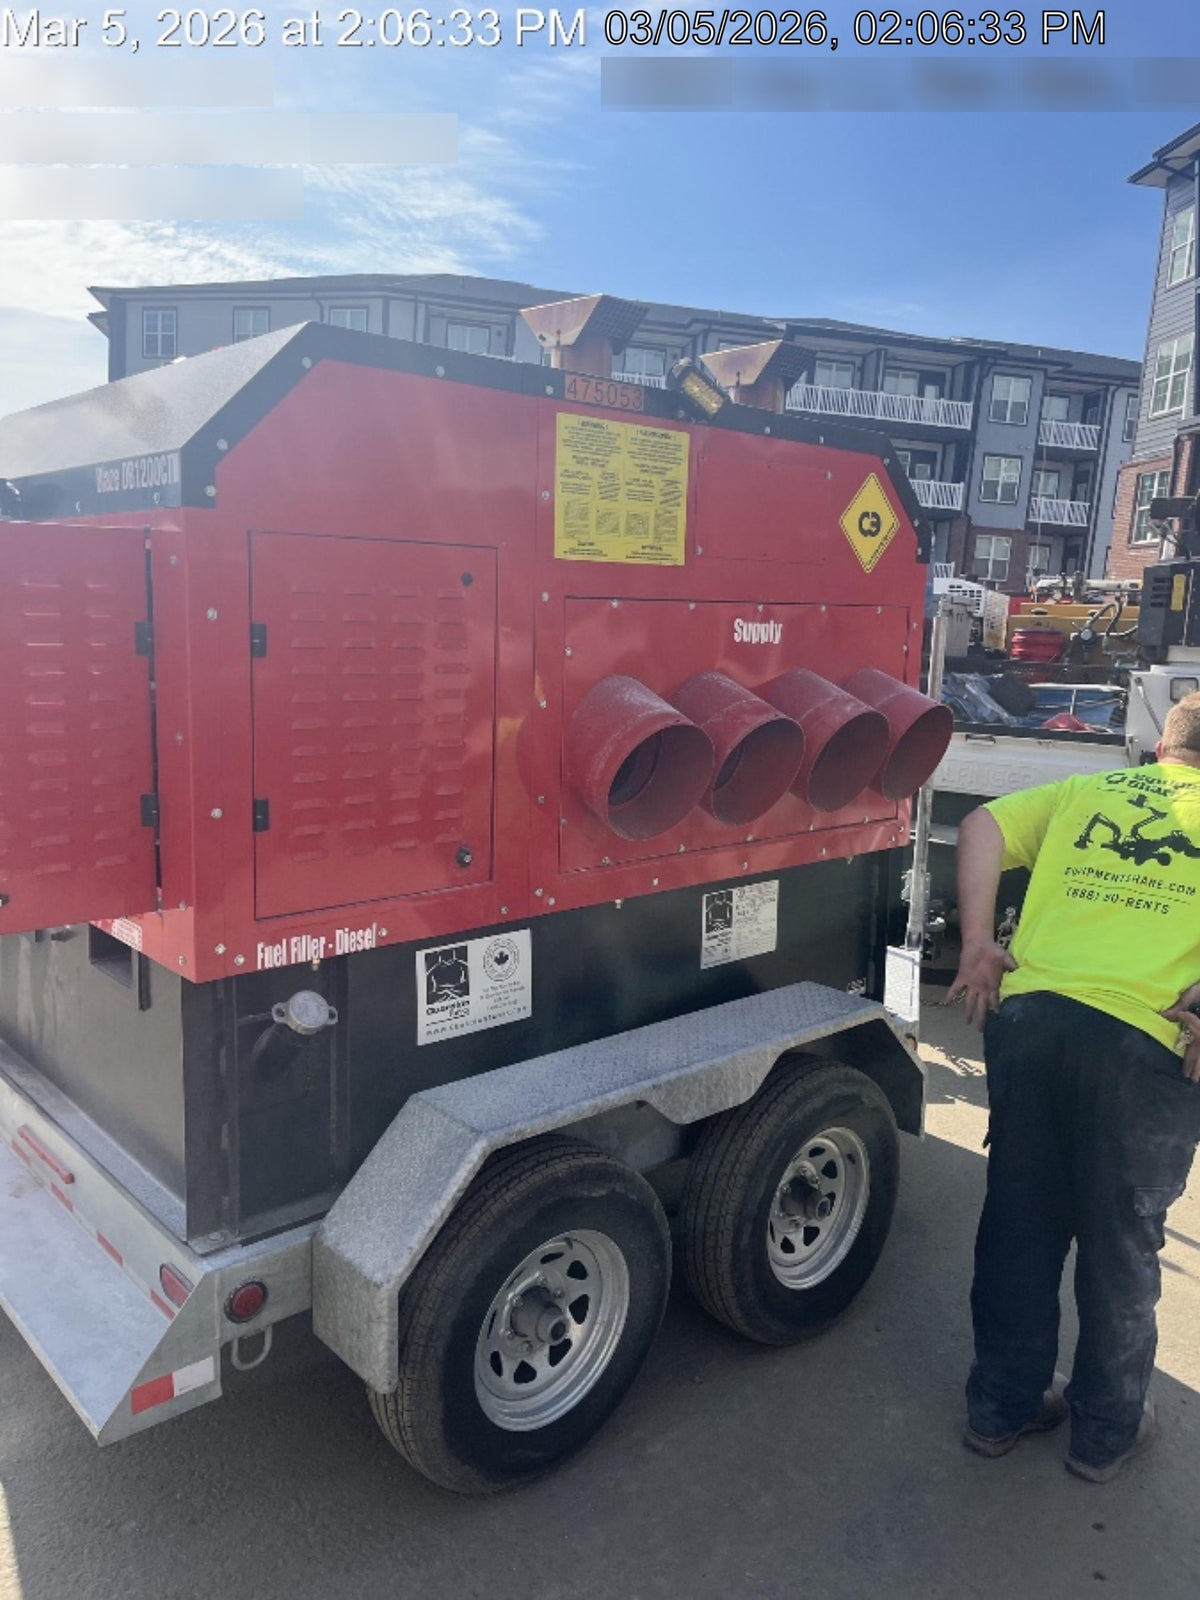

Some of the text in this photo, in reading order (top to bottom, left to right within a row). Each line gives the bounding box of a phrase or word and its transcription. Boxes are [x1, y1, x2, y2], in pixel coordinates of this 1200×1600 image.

[566, 376, 643, 410] 475053
[733, 617, 783, 645] Supply
[257, 941, 287, 971] Fuel
[291, 934, 326, 964] Filler
[335, 922, 377, 955] Diesel
